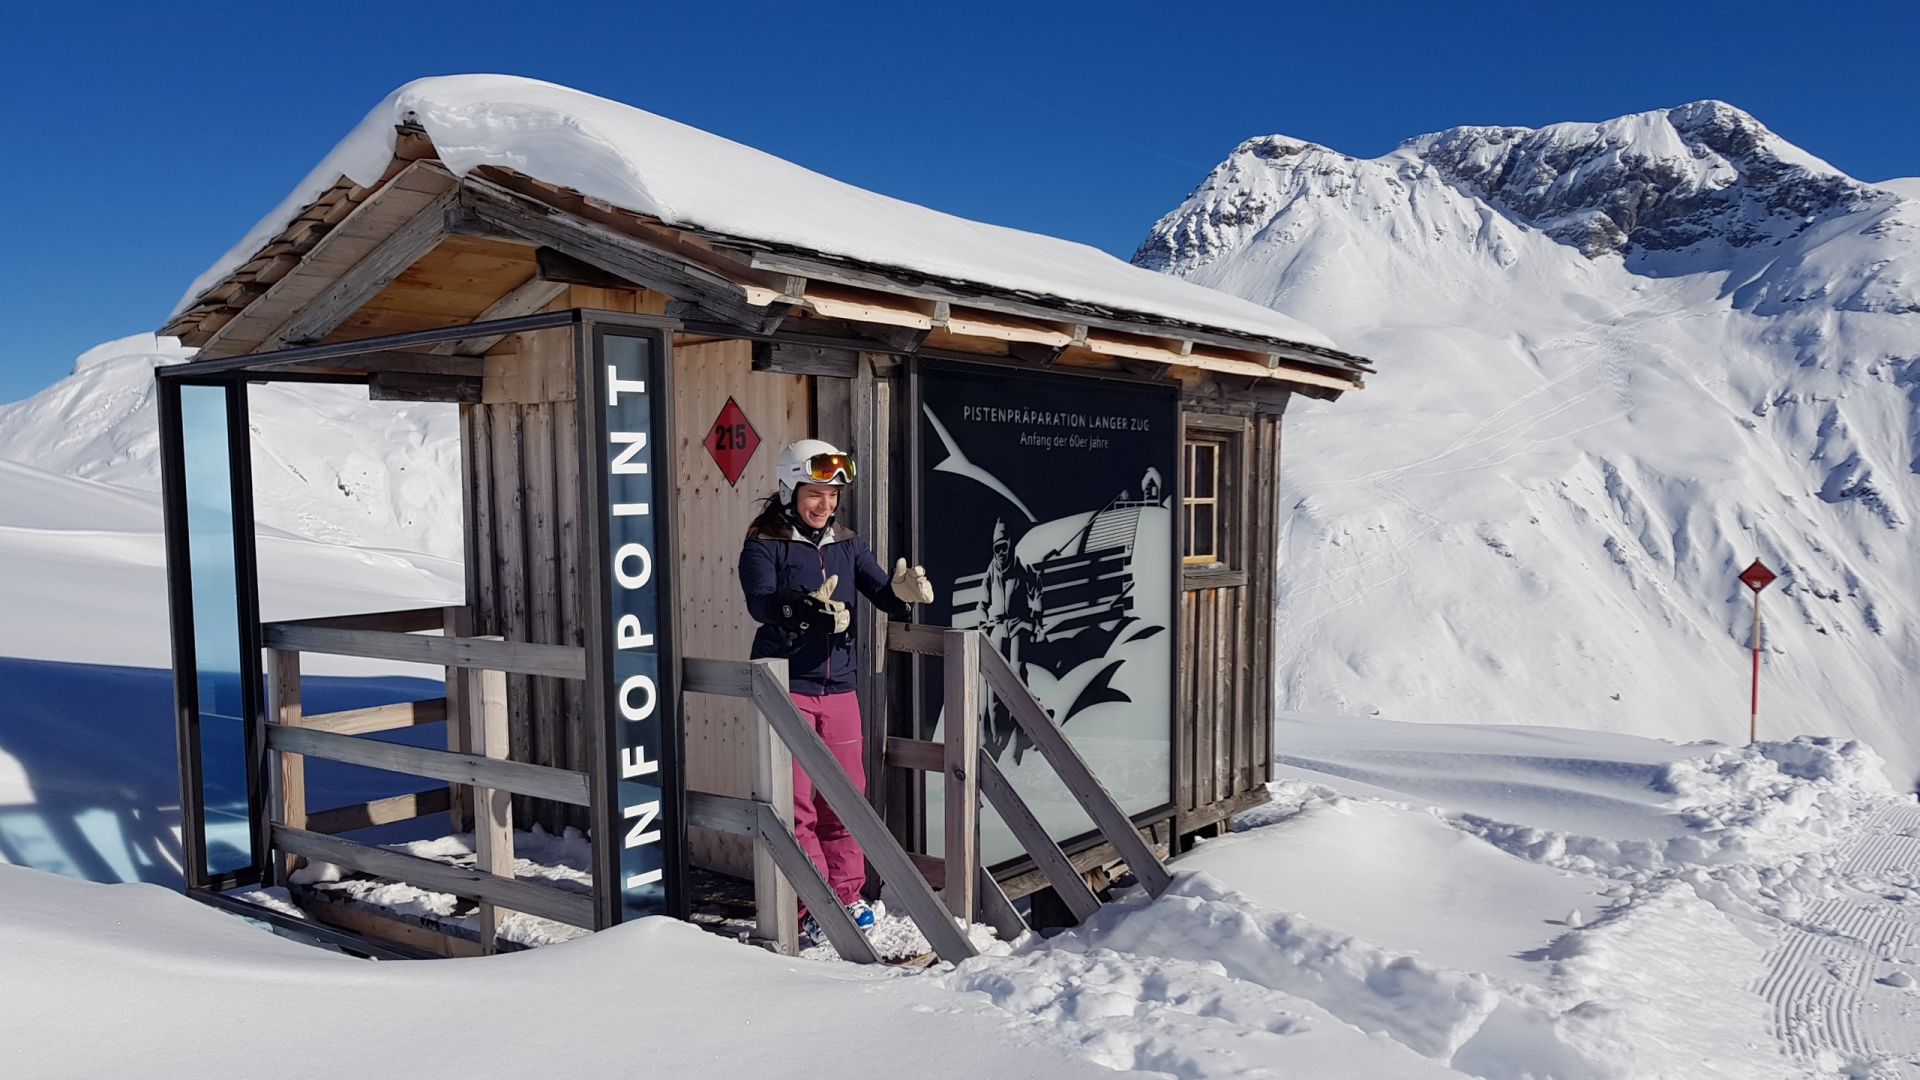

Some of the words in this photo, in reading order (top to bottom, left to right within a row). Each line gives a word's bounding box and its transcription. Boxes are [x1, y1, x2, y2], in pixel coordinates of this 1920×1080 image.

[964, 405, 1086, 428] PISTENPRÄPARATION
[1089, 414, 1128, 431] LANGER
[1130, 418, 1150, 431] ZUG
[715, 424, 746, 451] 215
[1020, 431, 1052, 450] Anfang
[1053, 433, 1067, 447] der
[1069, 435, 1087, 448] 60er
[1089, 436, 1109, 451] Jahre
[608, 365, 663, 889] INFOPOINT
